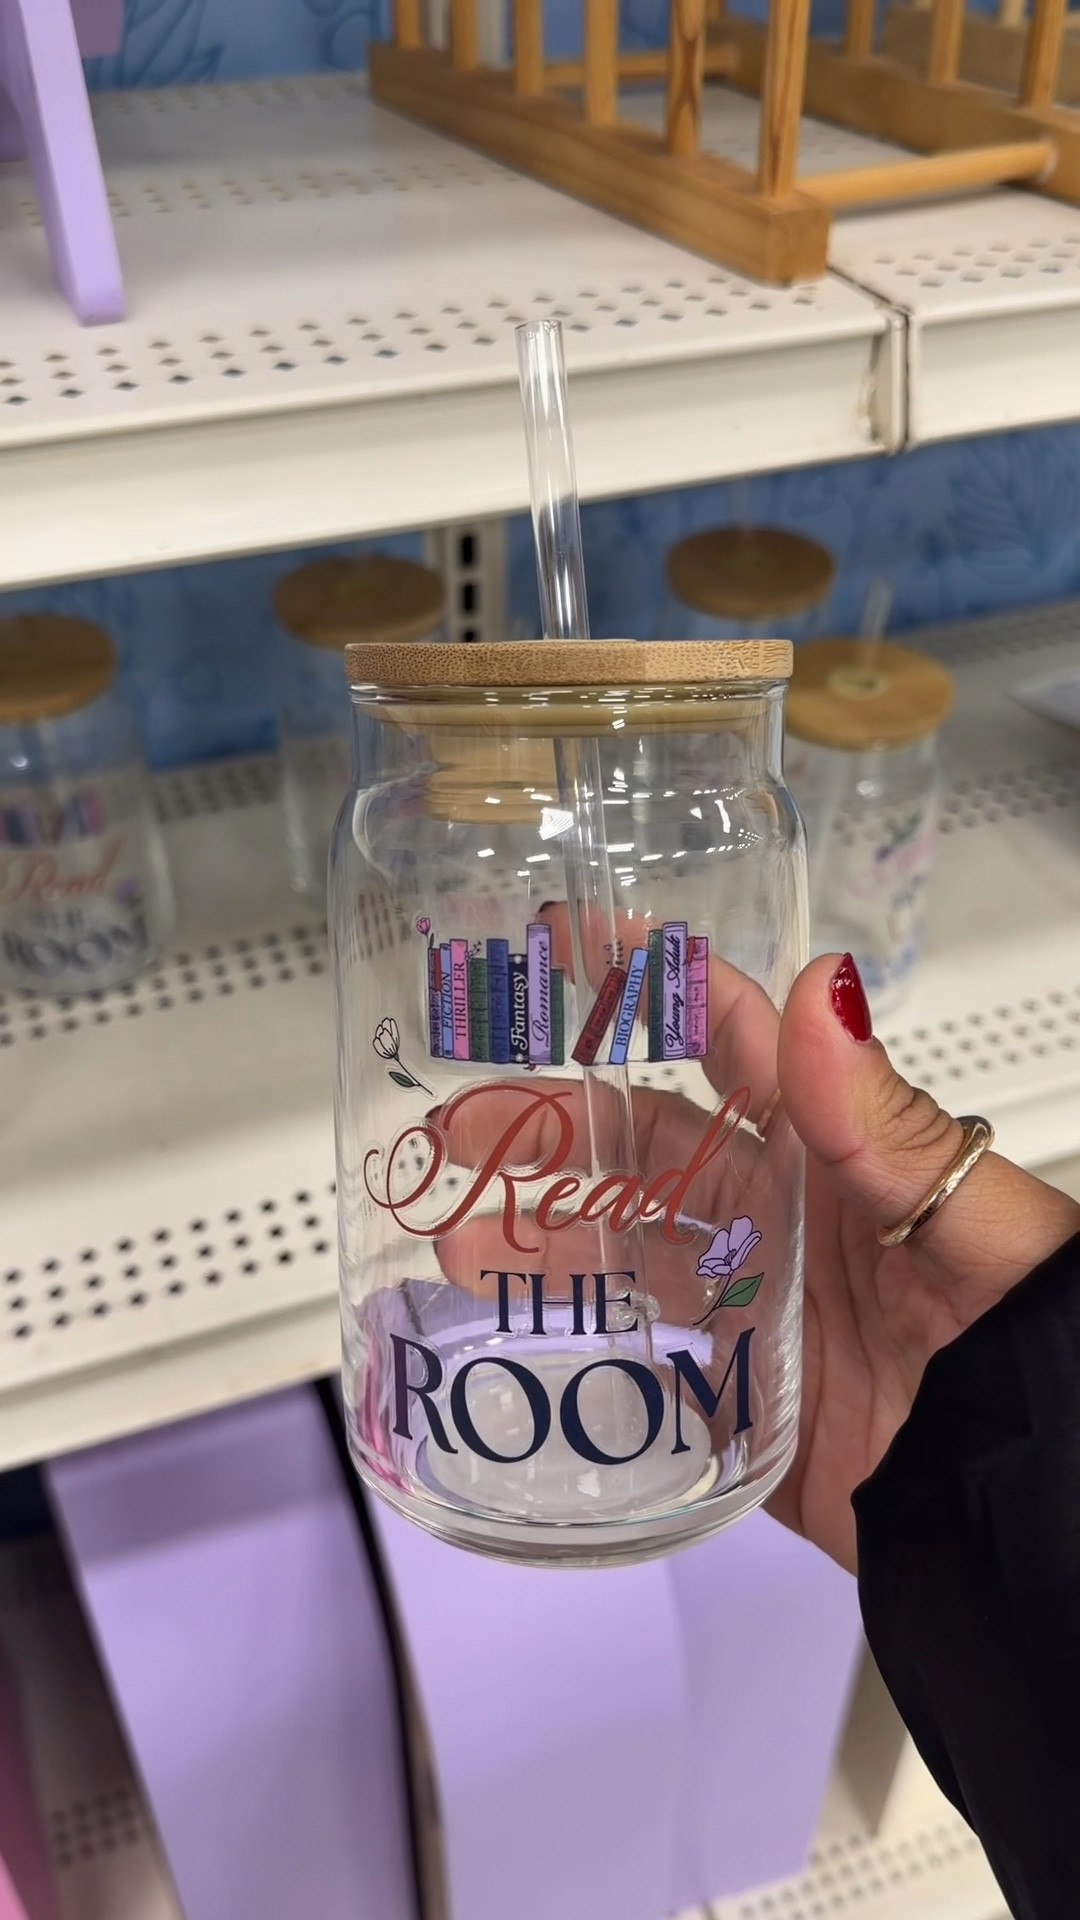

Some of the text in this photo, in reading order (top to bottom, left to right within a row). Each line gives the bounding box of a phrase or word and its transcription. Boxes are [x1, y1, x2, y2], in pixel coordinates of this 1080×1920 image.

[442, 971, 453, 1029] FICTION
[453, 962, 467, 1039] THRILLER
[510, 972, 529, 1050] Fantasy
[531, 940, 550, 1047] Romance
[615, 965, 643, 1046] BIOGRAPHY
[665, 934, 684, 1048] Young Adult
[363, 1083, 751, 1254] Read
[480, 1268, 639, 1336] THE
[390, 1326, 756, 1466] ROOM
